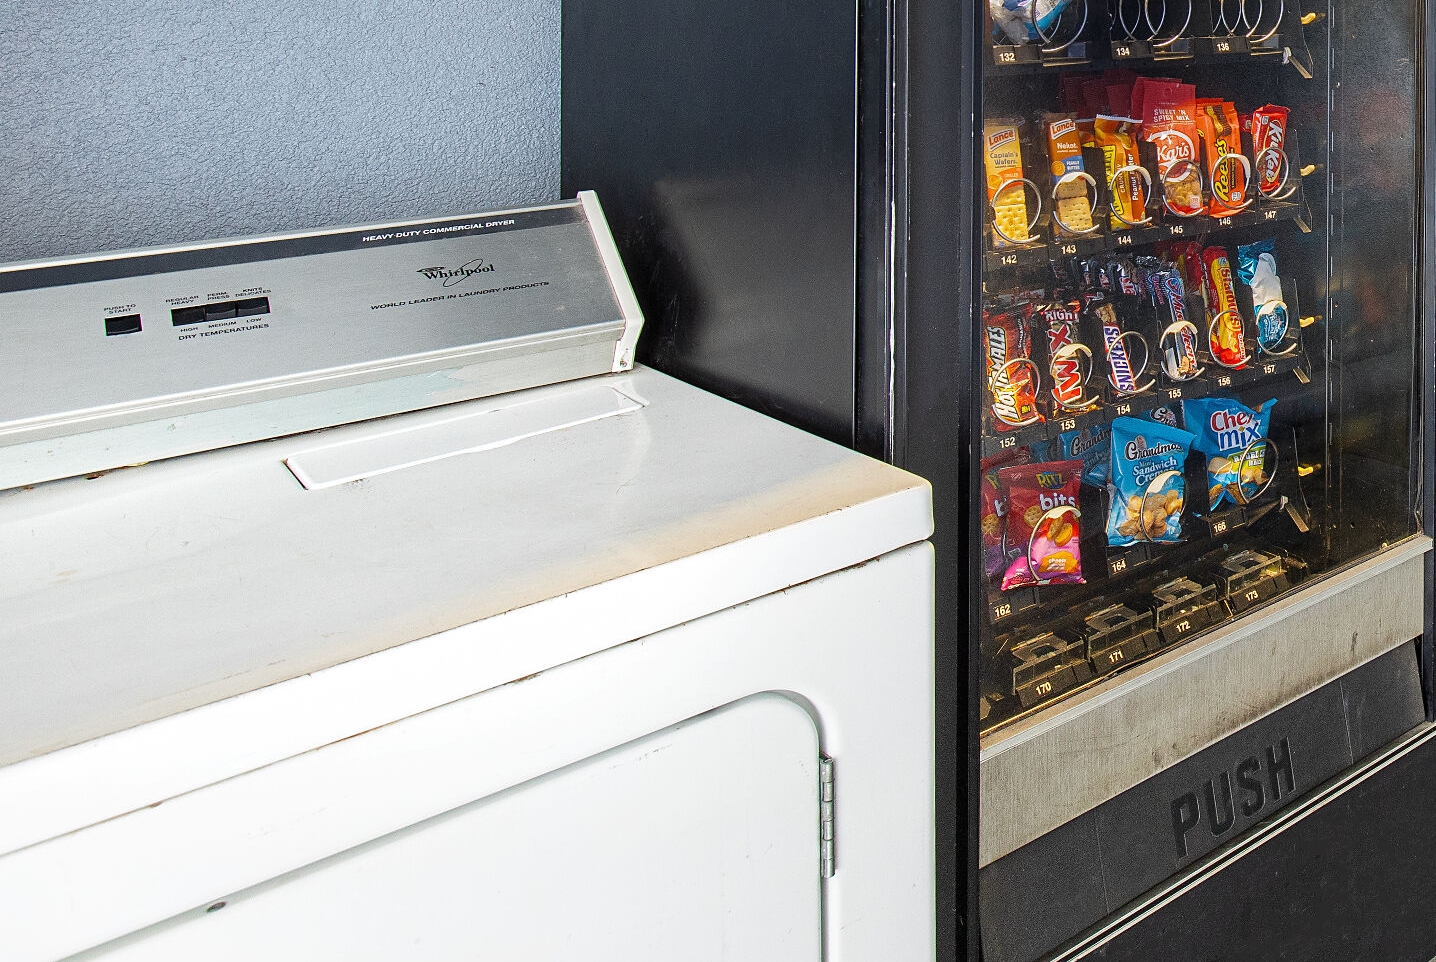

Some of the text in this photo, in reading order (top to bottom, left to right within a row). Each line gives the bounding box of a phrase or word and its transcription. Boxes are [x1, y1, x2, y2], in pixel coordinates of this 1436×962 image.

[1115, 47, 1130, 56] 134
[1216, 42, 1230, 52] 136
[999, 52, 1016, 62] 132
[1051, 120, 1075, 135] Lance
[988, 130, 1014, 145] Lance
[989, 151, 1019, 159] Captain's
[1215, 138, 1230, 202] Reese's
[1264, 211, 1277, 220] 147
[1218, 217, 1232, 226] 146
[423, 223, 485, 236] COMMERCIAL
[485, 219, 516, 229] DRYER
[1169, 226, 1184, 235] 145
[1117, 235, 1132, 245] 144
[1061, 245, 1077, 255] 143
[1001, 255, 1018, 265] 142
[422, 263, 496, 281] Whirlpool
[235, 289, 273, 298] DELICATES
[370, 301, 406, 310] WORLD
[408, 295, 446, 306] LEADER
[458, 287, 502, 298] LAUNDRY
[502, 281, 551, 292] PRODUCTS
[165, 295, 200, 304] REGULAR
[108, 307, 133, 315] START
[208, 321, 238, 329] MEDIUM
[178, 323, 271, 341] DRY TEMPERATURES
[1047, 323, 1085, 405] TWX
[1263, 365, 1275, 374] 157
[1168, 389, 1182, 398] 155
[1116, 405, 1131, 415] 154
[1060, 420, 1076, 431] 153
[1219, 422, 1262, 450] mix
[1000, 437, 1016, 448] 152
[1133, 457, 1178, 477] Sandwich
[1036, 473, 1067, 488] RITZ
[1039, 492, 1076, 511] bits
[1112, 560, 1127, 573] 164
[1245, 591, 1259, 602] 173
[994, 605, 1012, 617] 162
[1176, 621, 1191, 633] 172
[1109, 651, 1124, 663] 171
[1035, 681, 1052, 696] 170
[1171, 736, 1297, 861] PUSH
